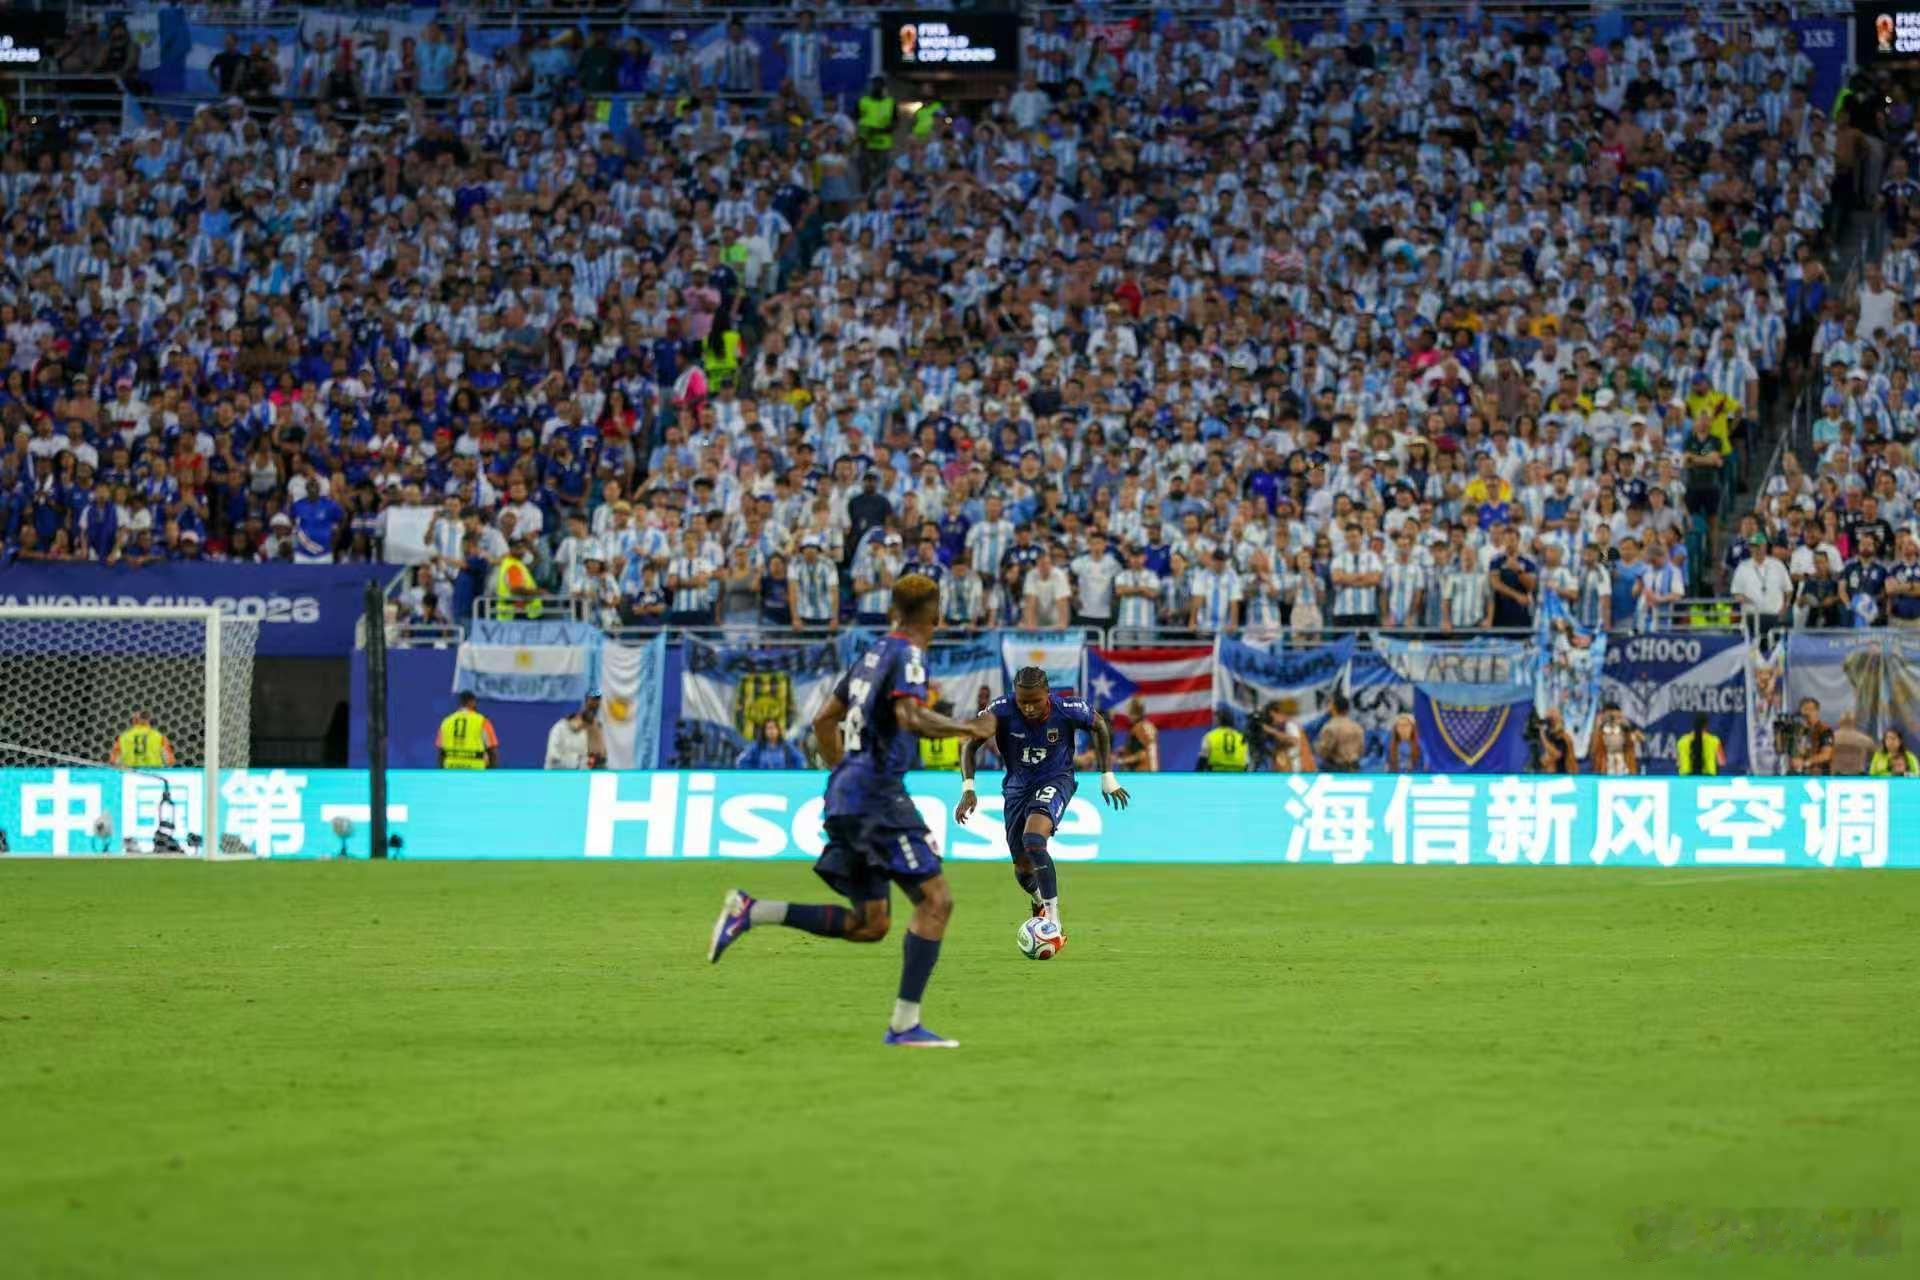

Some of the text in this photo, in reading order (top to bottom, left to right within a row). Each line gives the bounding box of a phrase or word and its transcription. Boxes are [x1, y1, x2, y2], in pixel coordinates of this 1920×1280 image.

[918, 23, 949, 36] FIFA
[918, 36, 969, 48] WORLD
[918, 48, 996, 61] CUP 2026
[212, 596, 320, 623] 2026
[1626, 638, 1701, 663] CHOCO
[1022, 747, 1047, 763] 13
[20, 769, 408, 857] 中国第一
[1284, 774, 1889, 867] 海信新风空调
